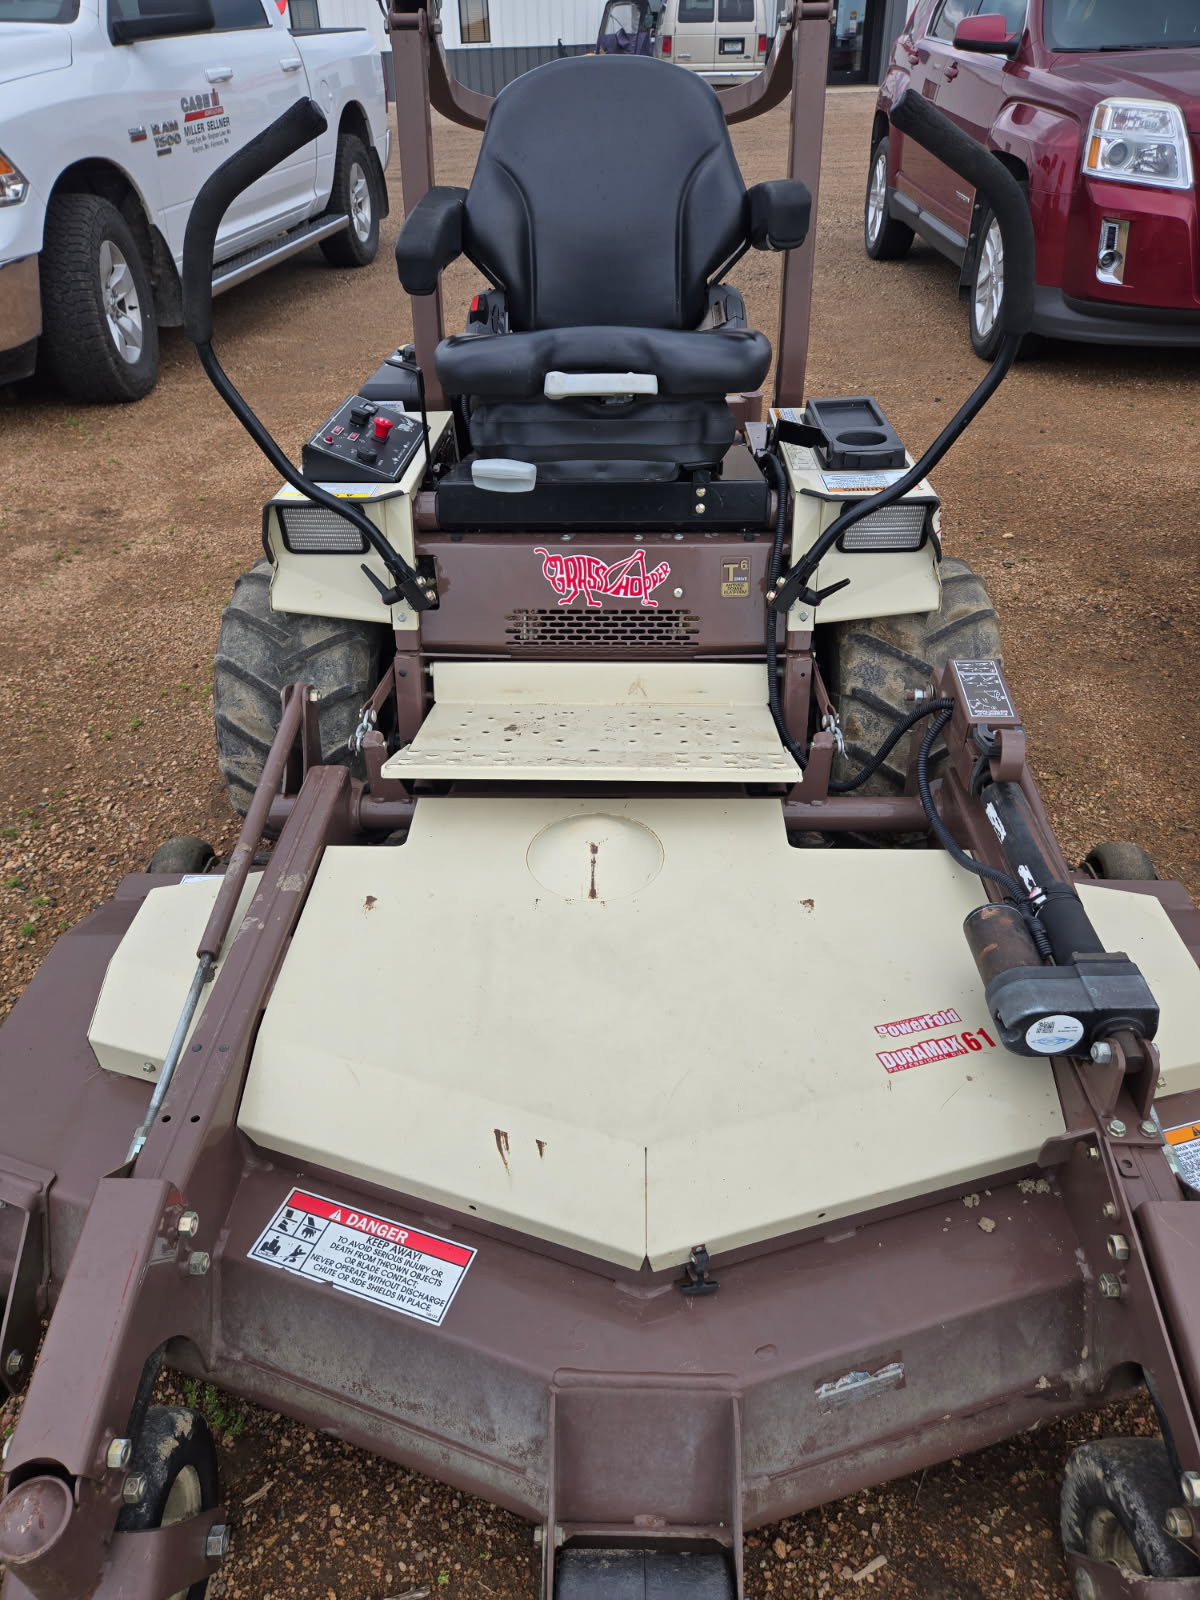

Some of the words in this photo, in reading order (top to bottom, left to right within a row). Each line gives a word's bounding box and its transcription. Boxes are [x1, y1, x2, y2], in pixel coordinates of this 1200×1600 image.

[154, 132, 181, 148] 1500
[184, 122, 205, 137] MILLER
[206, 116, 231, 132] SELLNER
[874, 1008, 962, 1038] PowerFold
[961, 1028, 996, 1051] 61
[888, 1054, 949, 1073] PROFESSIONAL
[949, 1049, 967, 1059] CUT
[346, 1213, 409, 1244] DANGER
[338, 1235, 348, 1244] TO
[348, 1240, 373, 1252] AVOID
[373, 1248, 403, 1264] SERIOUS
[403, 1259, 430, 1273] INJURY
[431, 1269, 443, 1278] OR
[366, 1236, 390, 1250] KEEP
[389, 1245, 422, 1262] AWAY!
[330, 1242, 354, 1255] DEATH
[354, 1251, 376, 1264] FROM
[376, 1259, 409, 1275] THROWN
[409, 1270, 443, 1287] OBJECTS
[344, 1256, 356, 1265] OR
[357, 1261, 380, 1274] BLADE
[381, 1269, 419, 1289] CONTACT;
[310, 1253, 334, 1266] NEVER
[335, 1262, 367, 1278] OPERATE
[367, 1273, 400, 1290] WITHOUT
[400, 1285, 445, 1307] DISCHARGE
[313, 1263, 337, 1277] CHUTE
[337, 1272, 350, 1282] OR
[350, 1276, 367, 1287] SIDE
[367, 1282, 397, 1298] SHIELDS
[397, 1293, 407, 1302] IN
[407, 1297, 432, 1312] PLACE.
